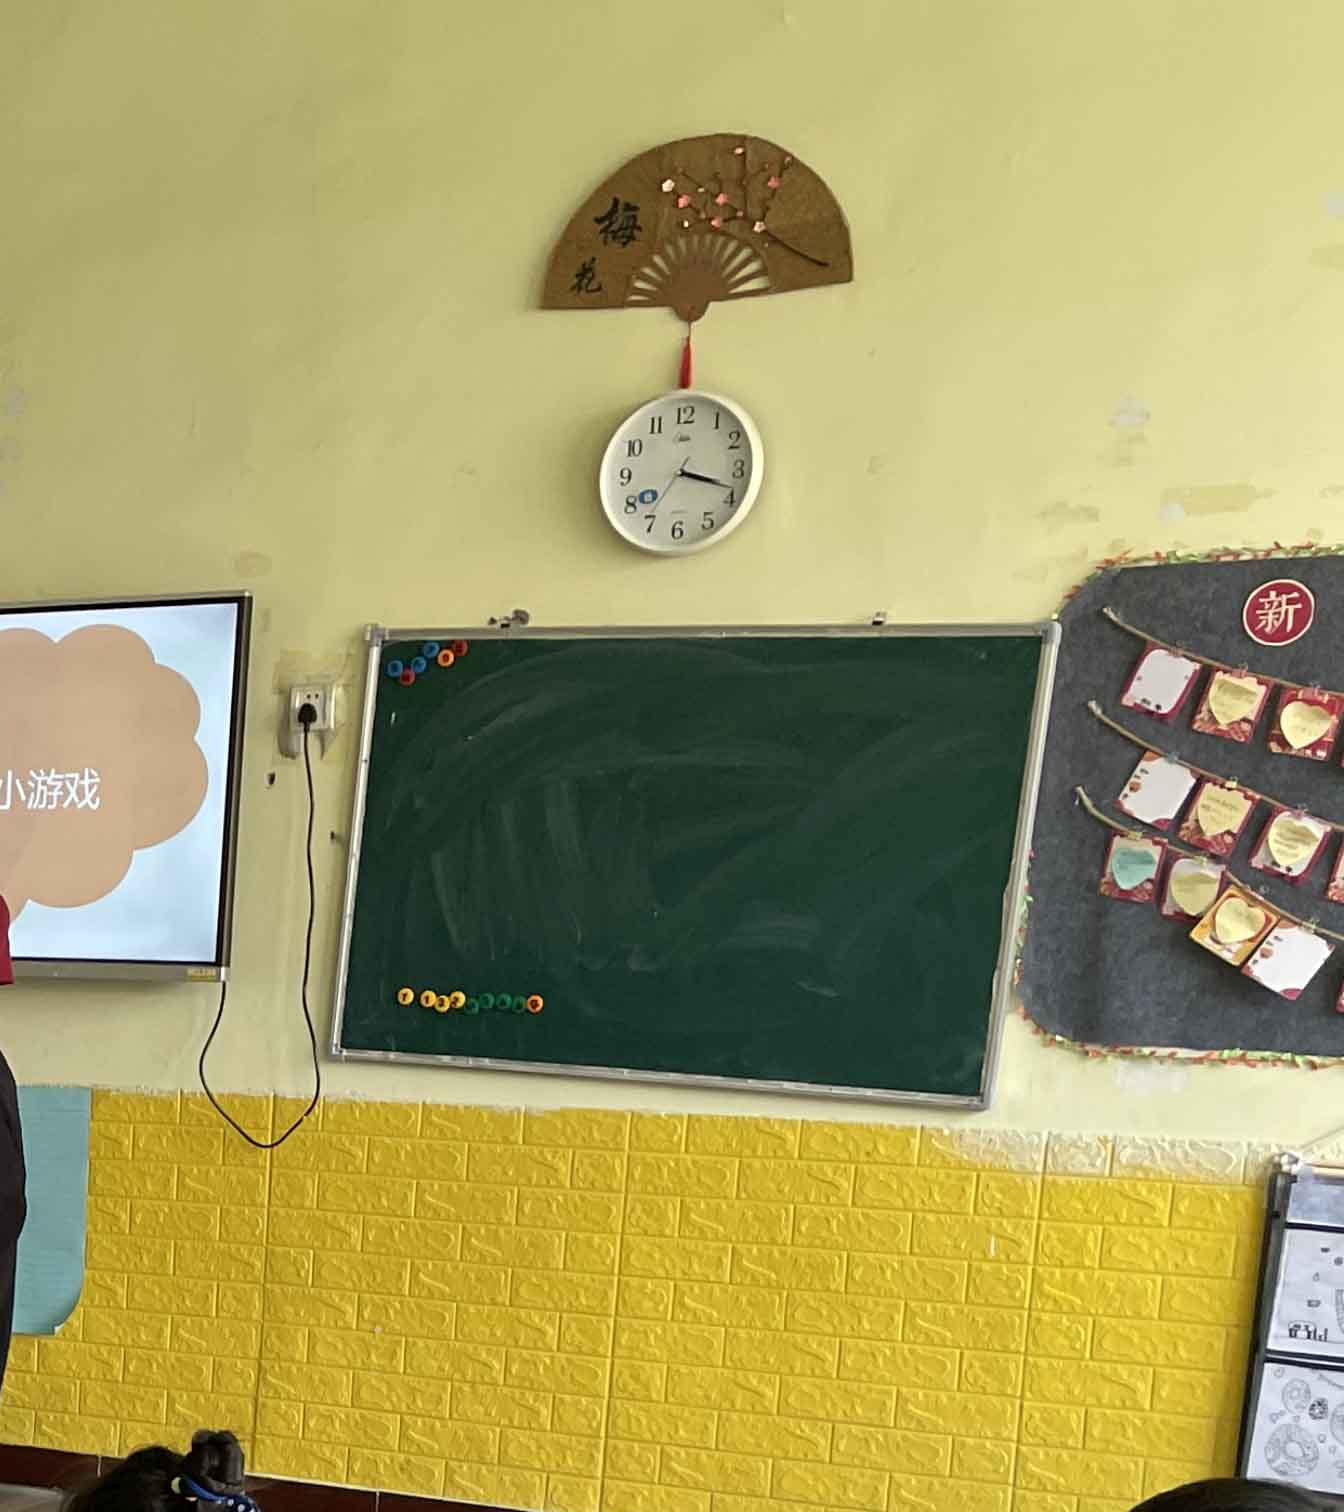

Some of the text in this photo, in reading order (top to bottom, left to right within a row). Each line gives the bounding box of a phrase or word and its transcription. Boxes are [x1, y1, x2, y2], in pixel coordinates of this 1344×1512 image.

[676, 406, 695, 425] 12
[713, 412, 720, 430] 1
[649, 416, 663, 435] 11
[627, 439, 643, 458] 10
[728, 431, 741, 450] 2
[619, 467, 632, 487] 9
[732, 459, 745, 479] 3
[624, 496, 637, 514] 8
[723, 487, 736, 508] 4
[644, 514, 656, 534] 7
[671, 520, 684, 540] 6
[701, 512, 714, 530] 5
[1255, 590, 1303, 634] 新
